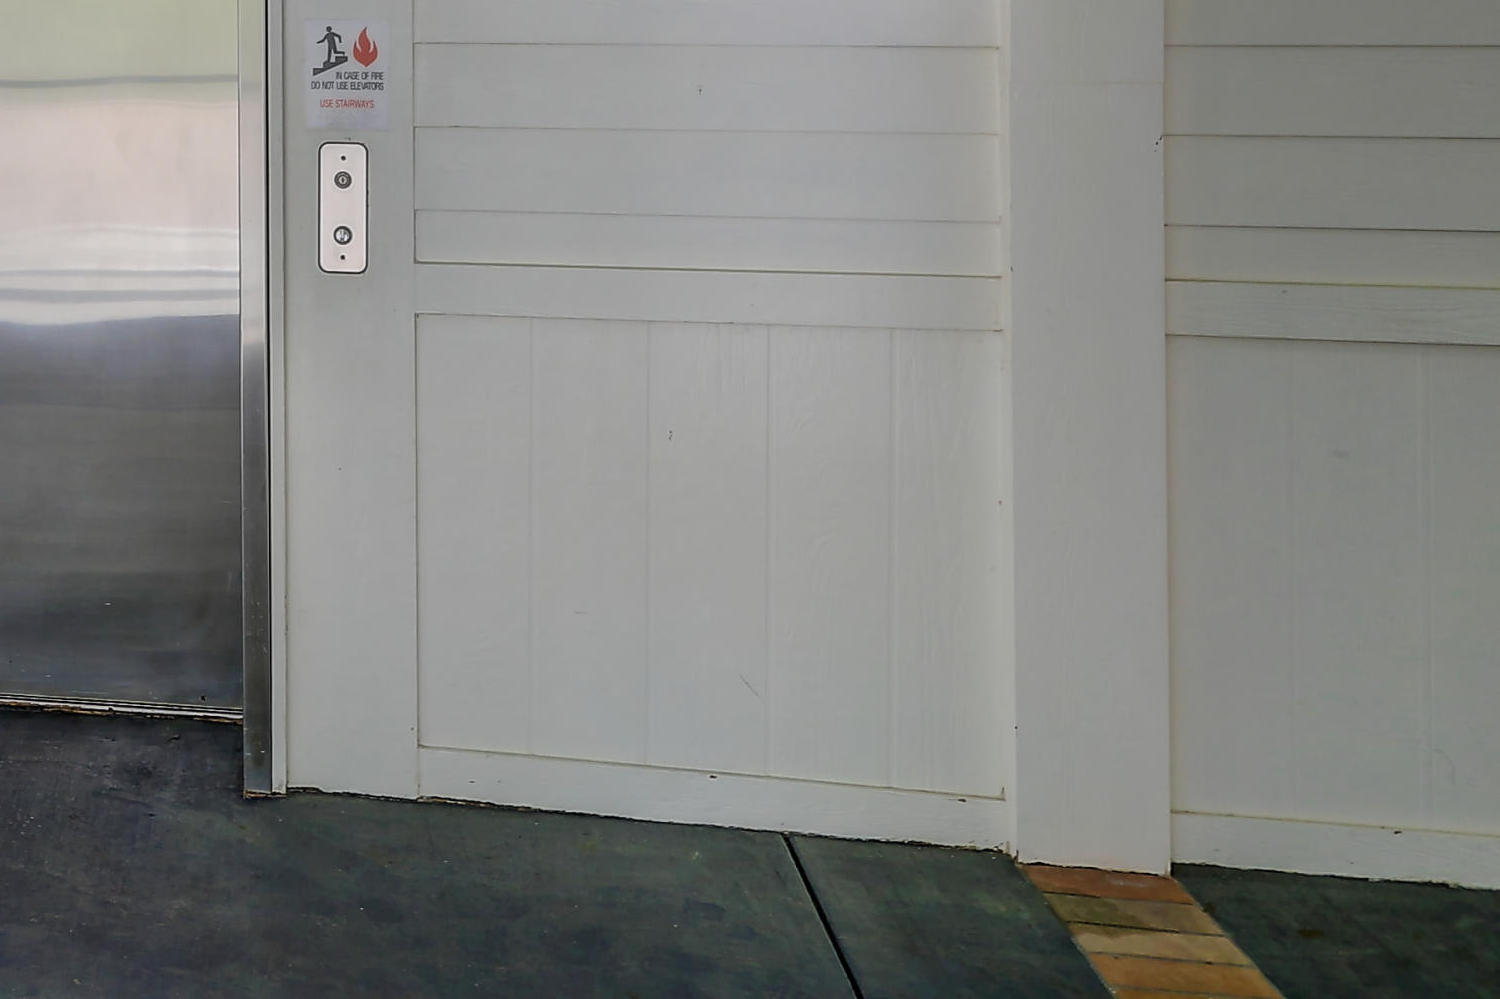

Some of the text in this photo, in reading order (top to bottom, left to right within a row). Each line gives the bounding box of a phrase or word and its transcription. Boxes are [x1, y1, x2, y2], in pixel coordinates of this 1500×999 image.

[336, 71, 384, 80] IN CASE OF FIRE
[311, 81, 384, 90] DO NOT USE ELEVATORS
[320, 99, 374, 108] USE STAIRWAYS
